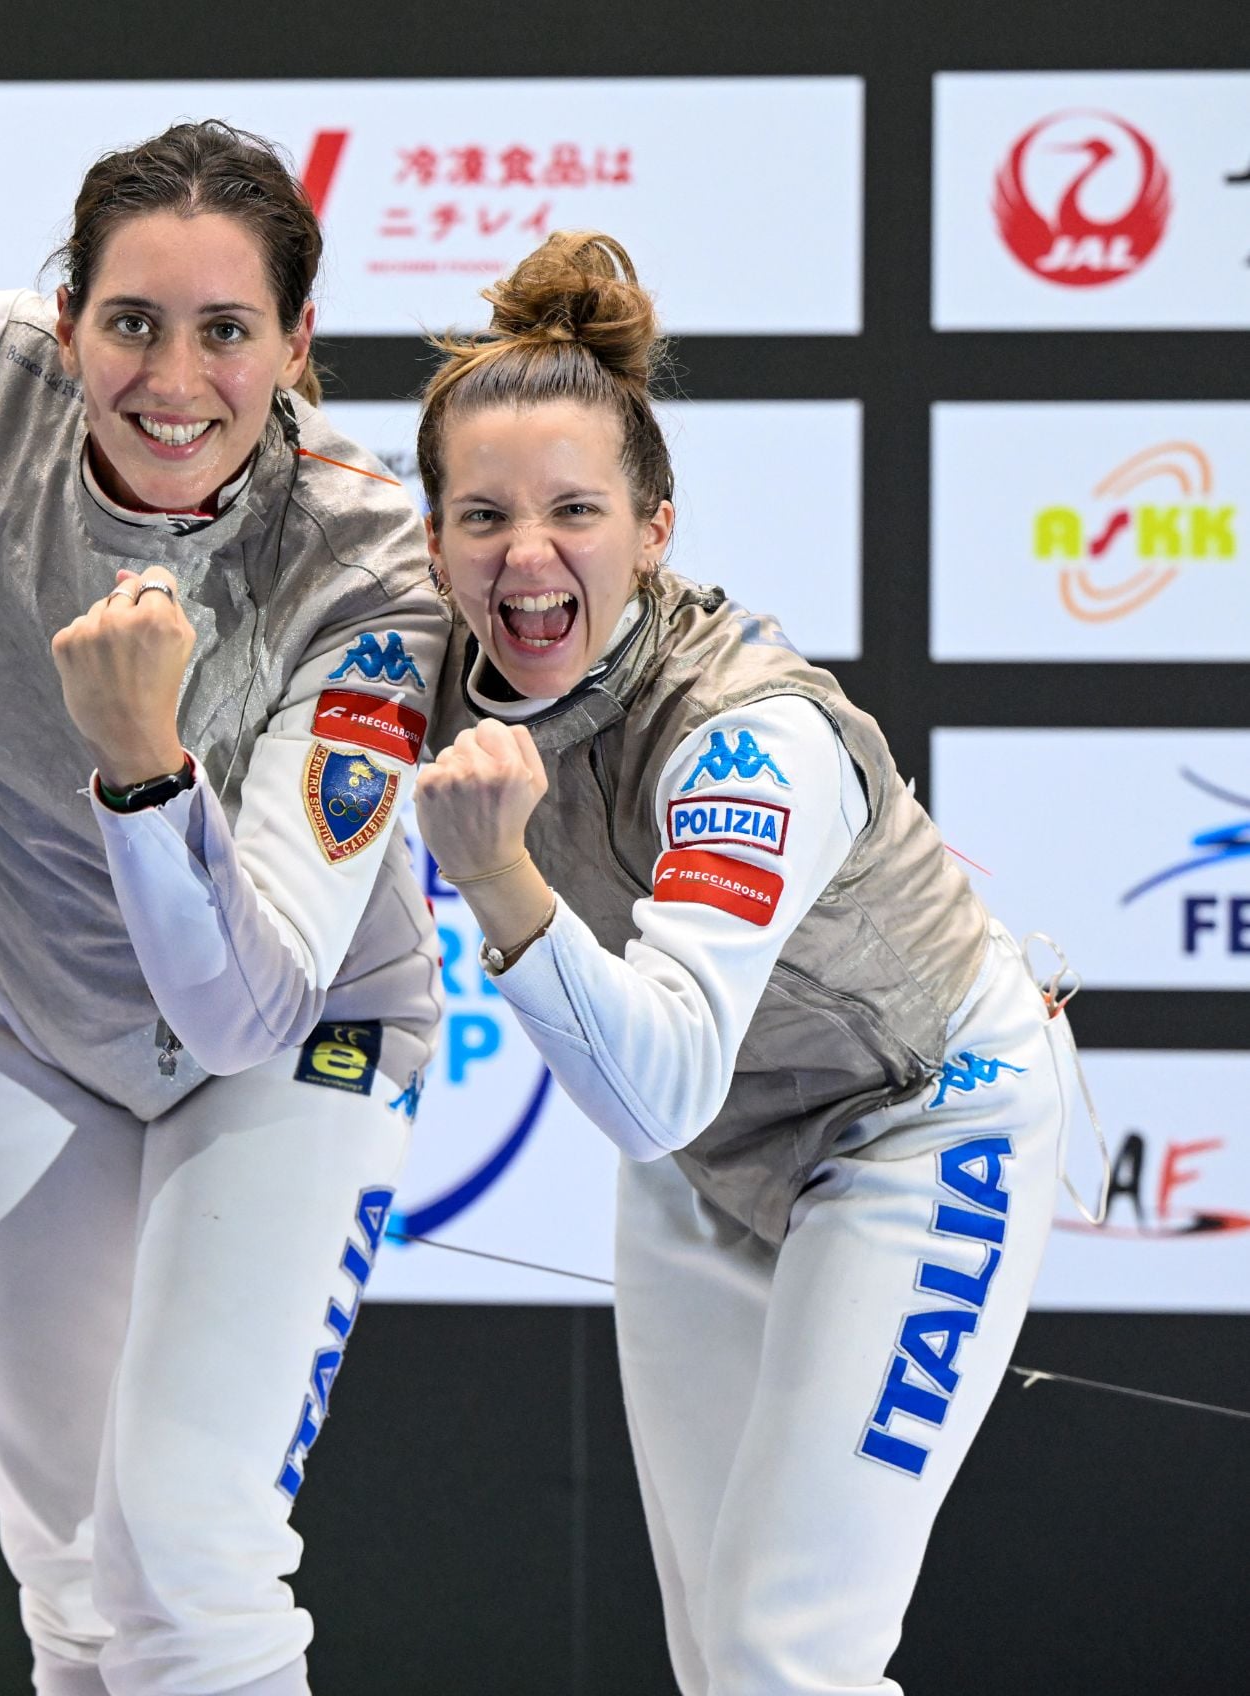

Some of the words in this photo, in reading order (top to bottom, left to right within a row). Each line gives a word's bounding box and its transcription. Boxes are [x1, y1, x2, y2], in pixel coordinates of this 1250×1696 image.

[395, 143, 634, 187] 冷凍食品は
[379, 202, 555, 240] ニチレイ
[1035, 235, 1139, 272] JAL
[350, 713, 421, 746] FRECCIAROSSA
[308, 749, 327, 794] CENTRO
[310, 797, 337, 851] SPORTIVO
[342, 784, 396, 853] CARABINIERI
[675, 807, 777, 842] POLIZIA
[679, 870, 772, 905] FRECCIAROSSA
[855, 1134, 1016, 1480] ITALIA
